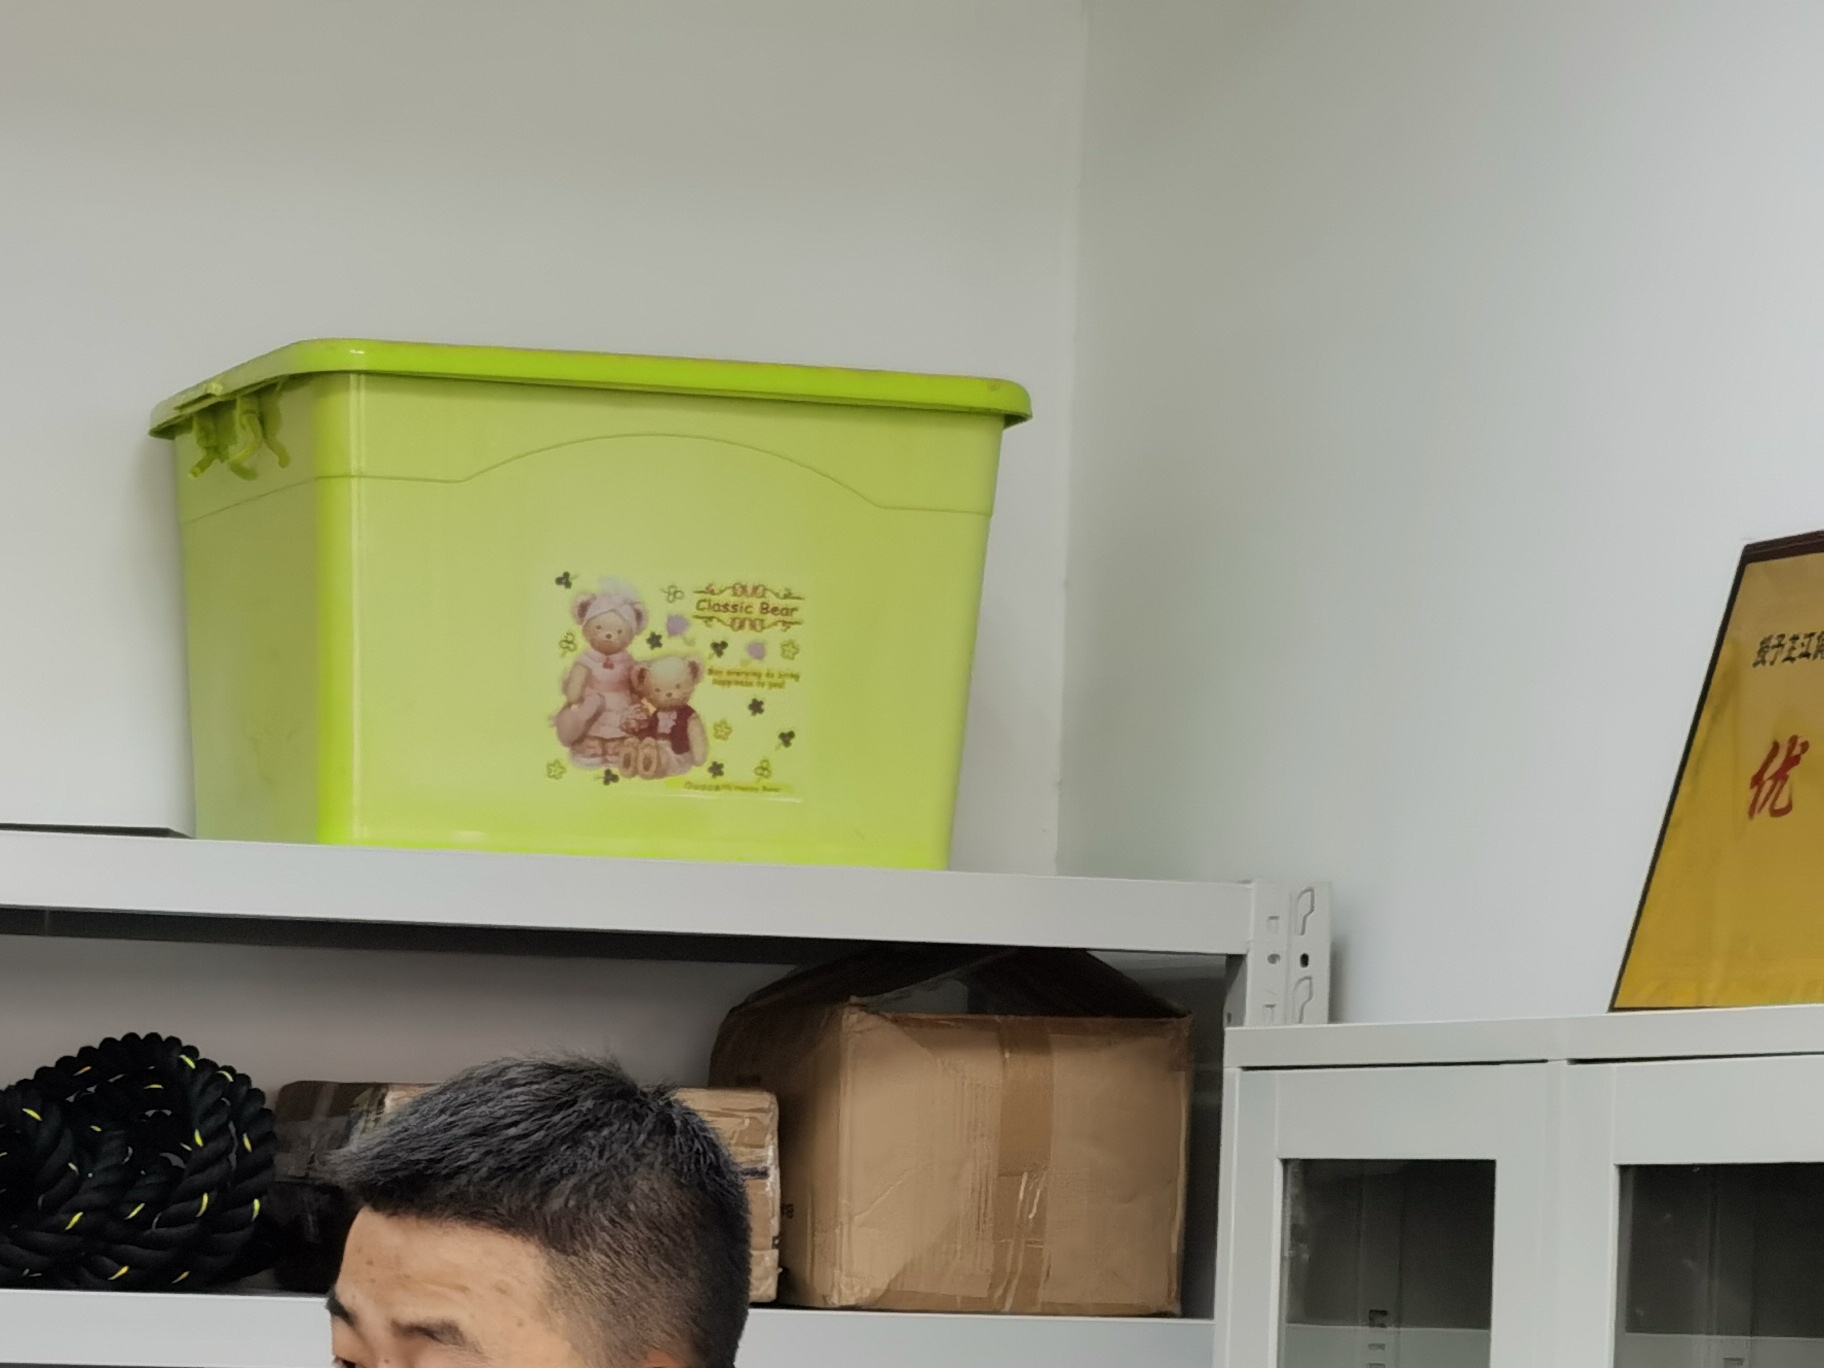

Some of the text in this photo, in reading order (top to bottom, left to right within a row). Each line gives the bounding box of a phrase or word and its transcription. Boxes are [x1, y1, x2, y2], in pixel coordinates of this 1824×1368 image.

[696, 599, 798, 617] Classic Bear
[1748, 735, 1810, 820] 优
